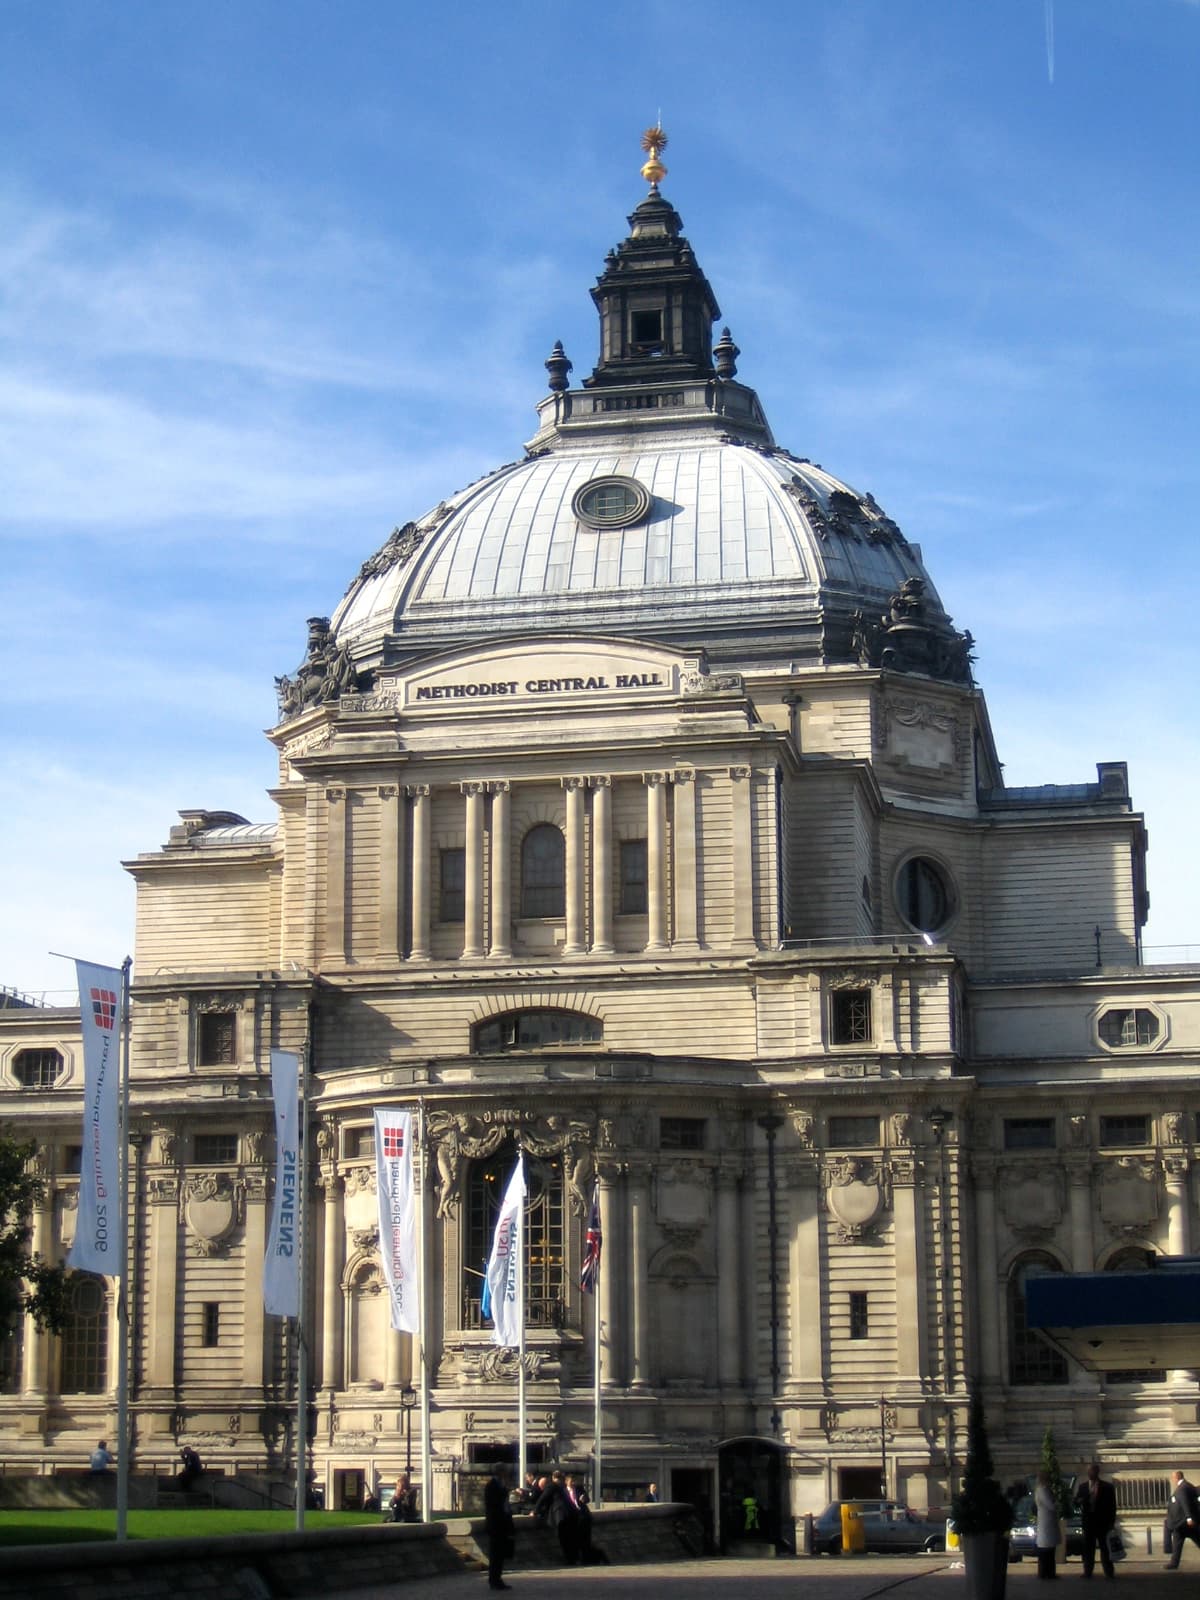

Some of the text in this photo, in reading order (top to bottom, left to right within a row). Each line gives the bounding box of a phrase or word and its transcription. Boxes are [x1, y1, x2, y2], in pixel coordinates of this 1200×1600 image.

[416, 673, 663, 699] METHODIST CENTRAL HALL
